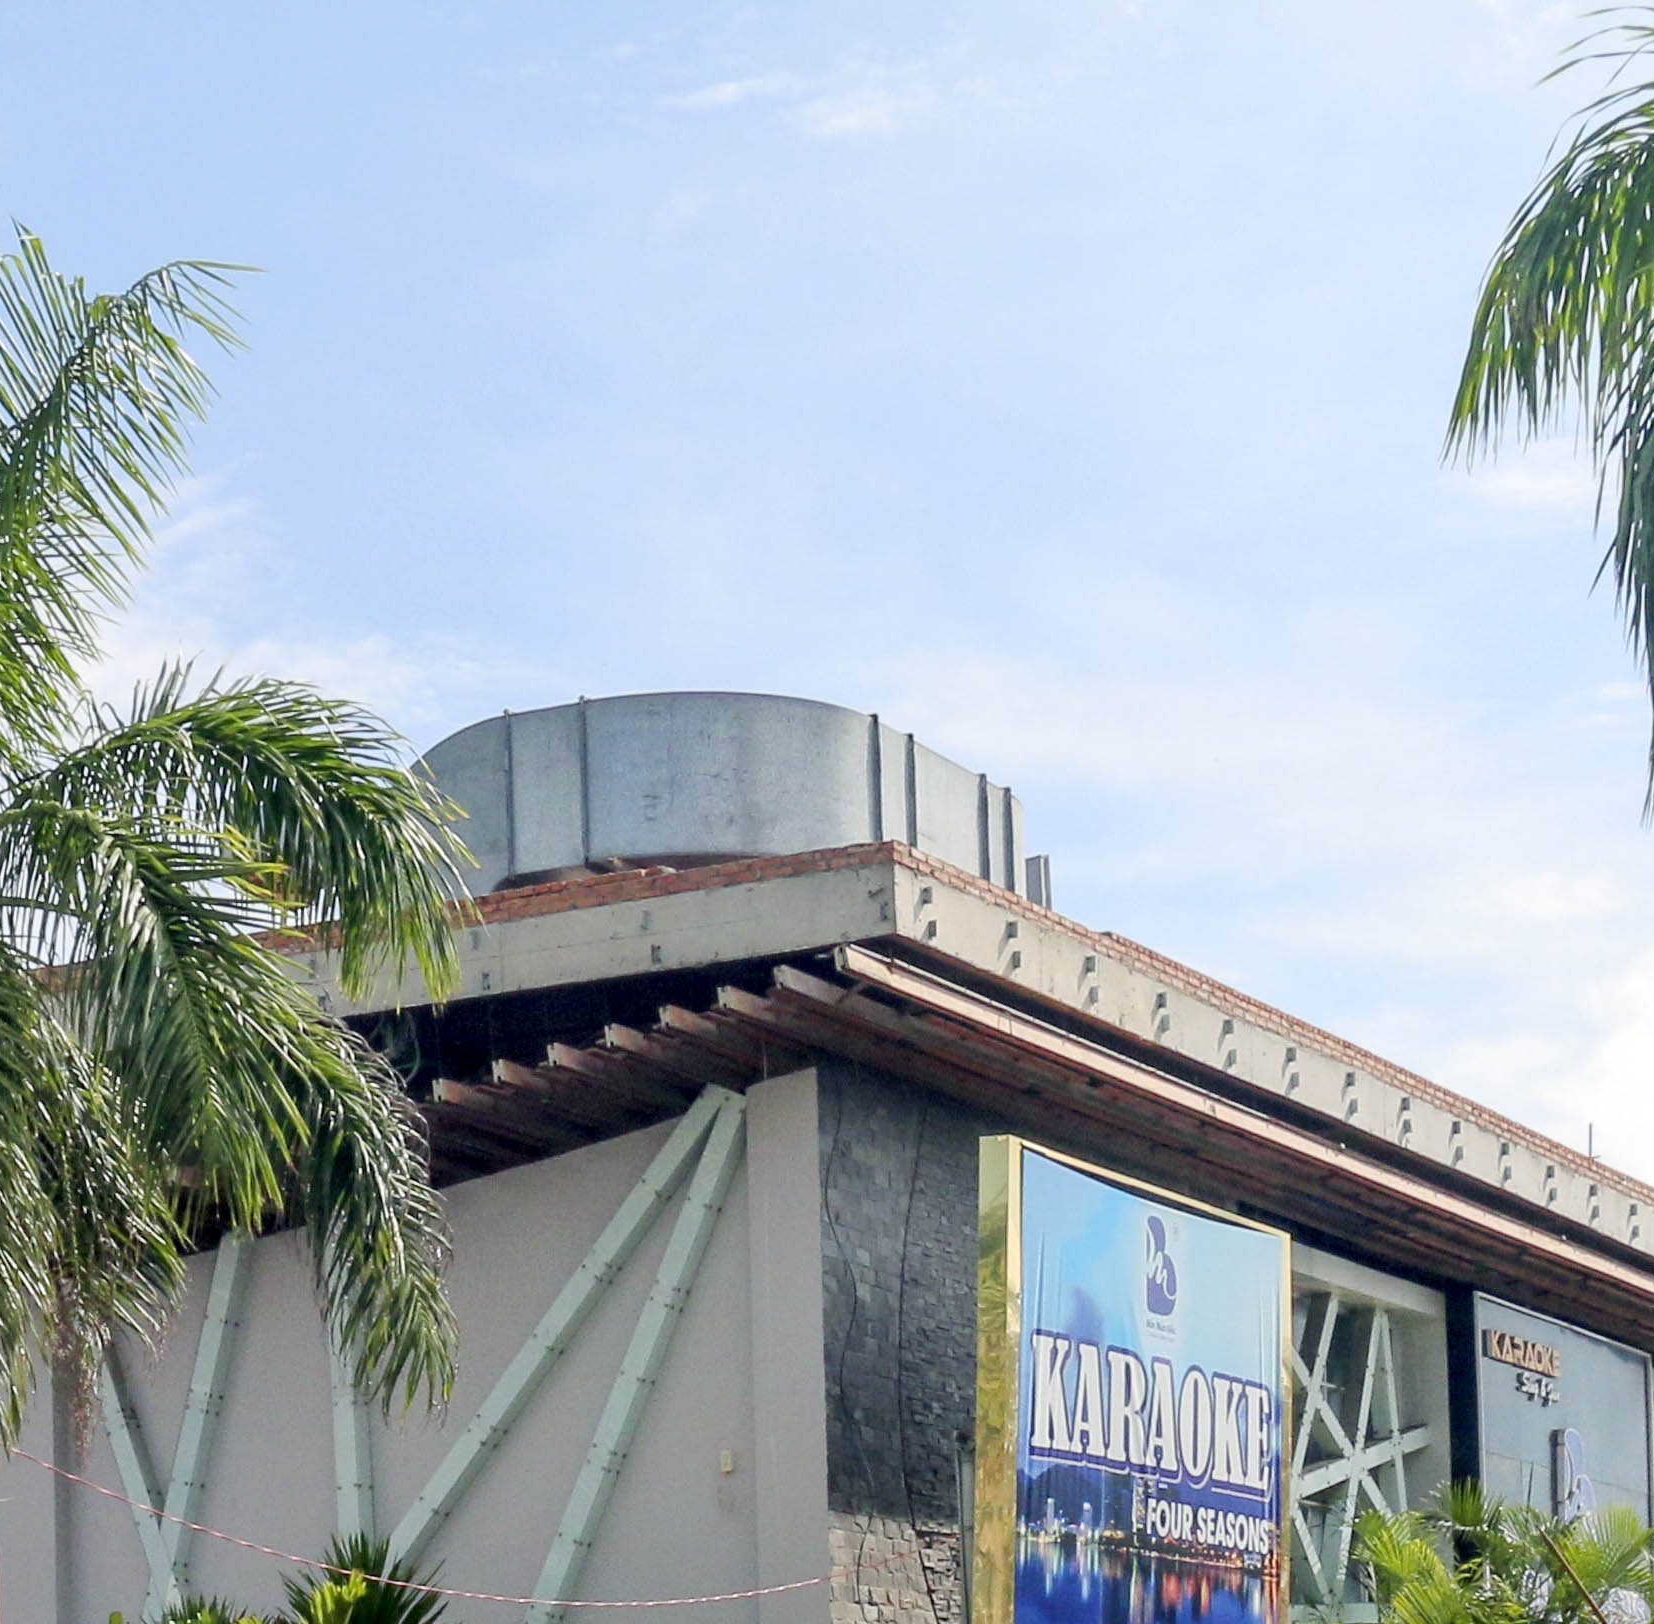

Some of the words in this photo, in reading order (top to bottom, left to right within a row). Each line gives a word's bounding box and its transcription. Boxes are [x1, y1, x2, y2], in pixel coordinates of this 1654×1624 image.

[1489, 1328, 1564, 1378] KARAOKE
[1031, 1331, 1273, 1494] KARAOKE
[1148, 1497, 1194, 1541] FOUR
[1197, 1506, 1270, 1555] SEASONS
